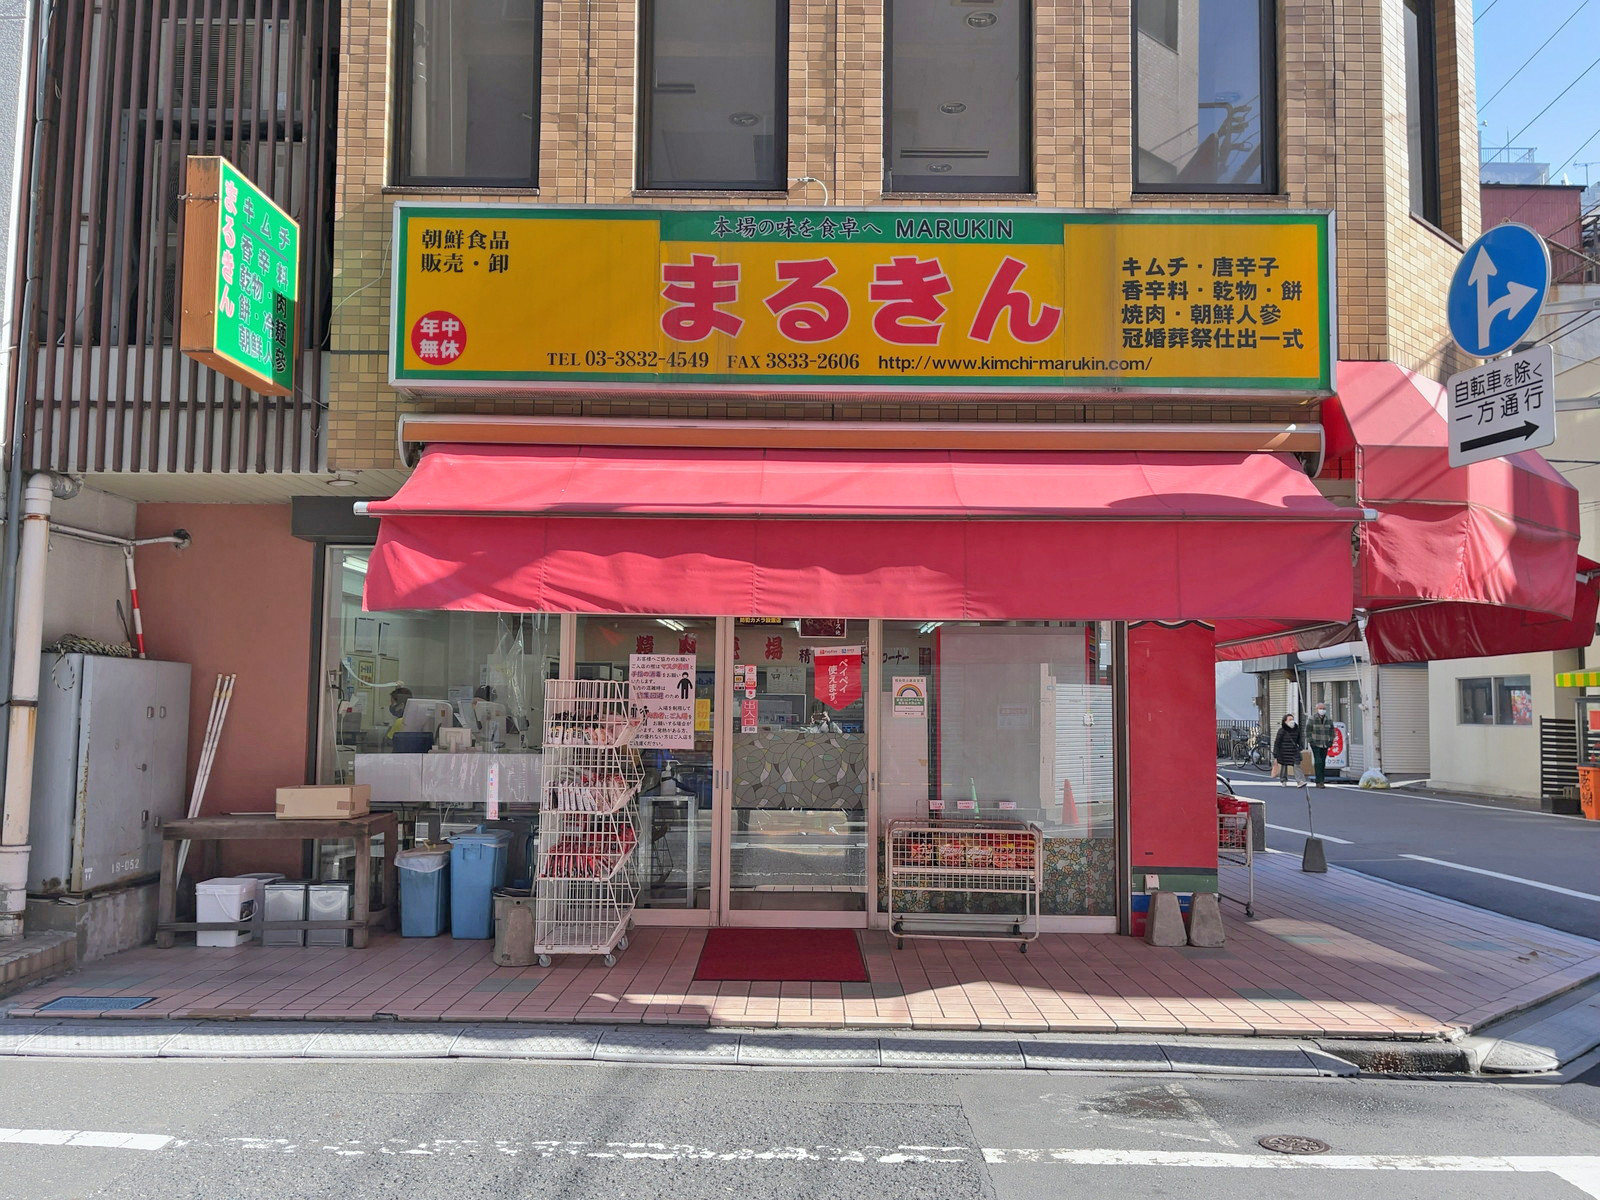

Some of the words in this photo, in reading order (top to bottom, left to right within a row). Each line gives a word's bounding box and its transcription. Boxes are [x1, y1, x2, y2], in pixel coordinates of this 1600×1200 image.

[243, 197, 290, 250] キムチ
[711, 215, 882, 240] 本場の味を食卓へ
[895, 218, 1013, 240] MARUKIN
[219, 179, 238, 318] まるきん
[421, 229, 510, 250] 朝鮮食品
[241, 233, 287, 292] 香辛料
[421, 253, 510, 273] 販売・卸
[1121, 256, 1280, 277] キムチ・唐辛子
[661, 253, 1062, 345] まるきん
[1121, 280, 1303, 301] 香辛料・乾物・餅
[420, 317, 460, 337] 年中
[1121, 328, 1305, 350] 冠婚葬祭仕出一式
[419, 339, 460, 359] 無休
[547, 352, 581, 367] TEL
[585, 350, 709, 368] 03-3832-4549
[727, 354, 761, 369] FAX
[766, 352, 860, 370] 3833-2606
[879, 355, 1152, 372] http://www.kimchi-marukin.com/
[1455, 360, 1543, 404] 自転車を除く
[1455, 385, 1544, 425] 一方通行
[828, 664, 838, 704] 使えます。
[839, 658, 849, 695] ペイペイ
[744, 701, 756, 726] 出入口
